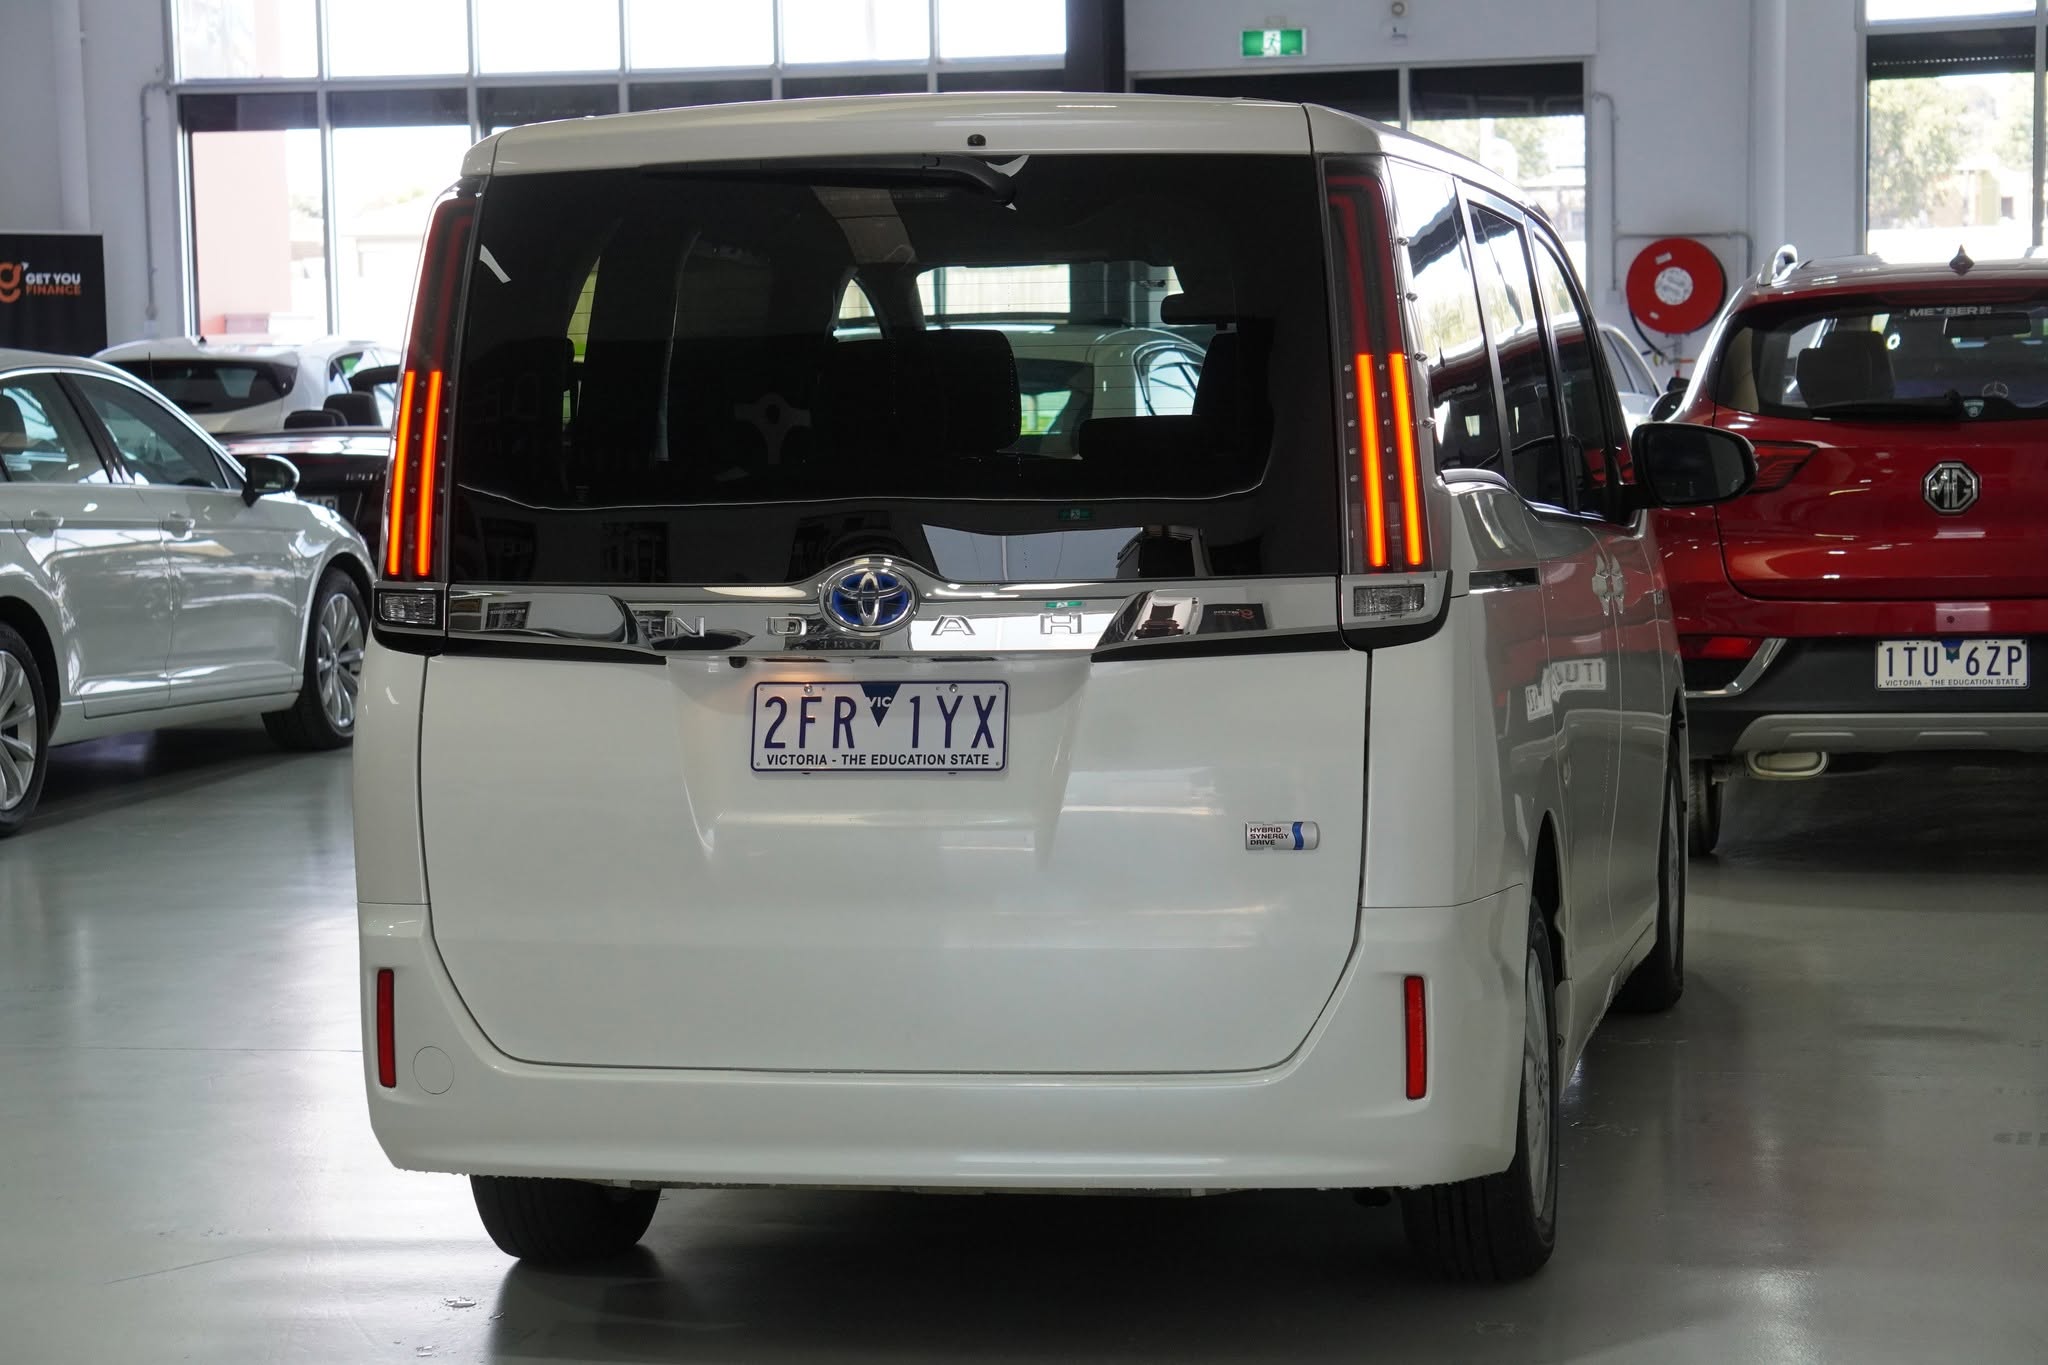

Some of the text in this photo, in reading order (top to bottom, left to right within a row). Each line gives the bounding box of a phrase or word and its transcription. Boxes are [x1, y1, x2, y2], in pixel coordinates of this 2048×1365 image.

[25, 272, 81, 285] GET YOU
[26, 285, 81, 296] FINANCE
[1930, 469, 1972, 508] MG
[1886, 646, 2022, 677] 1TU 6ZP
[1996, 678, 2020, 686] STATE
[867, 697, 893, 708] VIC
[764, 695, 997, 748] 2FR 1YX
[766, 754, 828, 766] VICTORIA
[841, 754, 867, 765] THE
[871, 753, 946, 765] EDUCATION
[951, 753, 989, 765] STATE
